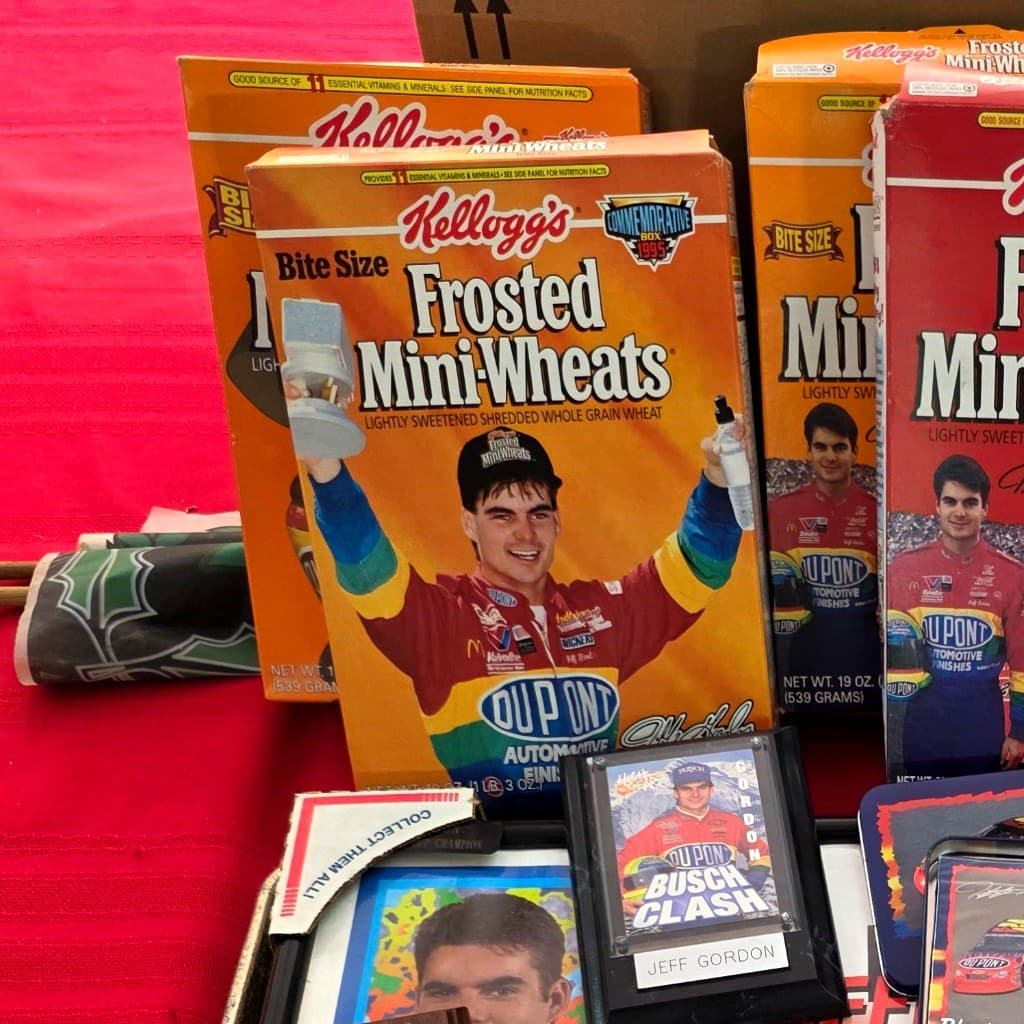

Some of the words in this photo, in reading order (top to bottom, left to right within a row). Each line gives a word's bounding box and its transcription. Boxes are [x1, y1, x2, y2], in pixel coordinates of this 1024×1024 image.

[844, 44, 939, 63] Kellogg's
[233, 75, 257, 85] GOOD
[258, 76, 289, 86] SOURCE
[290, 77, 302, 86] OF
[328, 79, 367, 90] ESSENTIAL
[368, 81, 401, 91] VITAMINS
[410, 83, 446, 93] MINERALS
[450, 85, 465, 94] SEE
[467, 85, 483, 95] SIDE
[484, 86, 508, 96] PANEL
[509, 87, 524, 96] FOR
[525, 87, 563, 97] NUTRITION
[564, 88, 587, 99] FACTS
[401, 189, 571, 258] Kellogg's
[606, 204, 691, 236] COMMEMORATIVE
[637, 241, 667, 259] 1995
[640, 231, 662, 241] BOX
[773, 227, 804, 253] BITE
[805, 225, 836, 251] SIZE
[275, 251, 331, 281] Bite
[334, 249, 390, 279] Size
[403, 257, 607, 337] Frosted
[355, 333, 673, 411] Mini-Wheats
[802, 385, 852, 400] LIGHTLY
[364, 414, 409, 430] LIGHTLY
[411, 411, 479, 429] SWEETENED
[481, 408, 540, 426] SHREDDED
[543, 407, 584, 424] WHOLE
[585, 406, 621, 423] GRAIN
[622, 404, 664, 421] WHEAT
[928, 427, 979, 445] LIGHTLY
[783, 675, 808, 688] NET
[810, 675, 834, 688] WT.
[838, 675, 852, 688] 19
[854, 675, 875, 688] OZ.
[784, 690, 812, 705] (539
[819, 690, 865, 705] GRAMS)
[366, 808, 432, 848] COLLECT
[328, 845, 367, 875] THEM
[643, 864, 750, 901] BUSCH
[631, 887, 771, 929] CLASH
[647, 956, 689, 977] JEFF
[697, 944, 776, 970] GORDON
